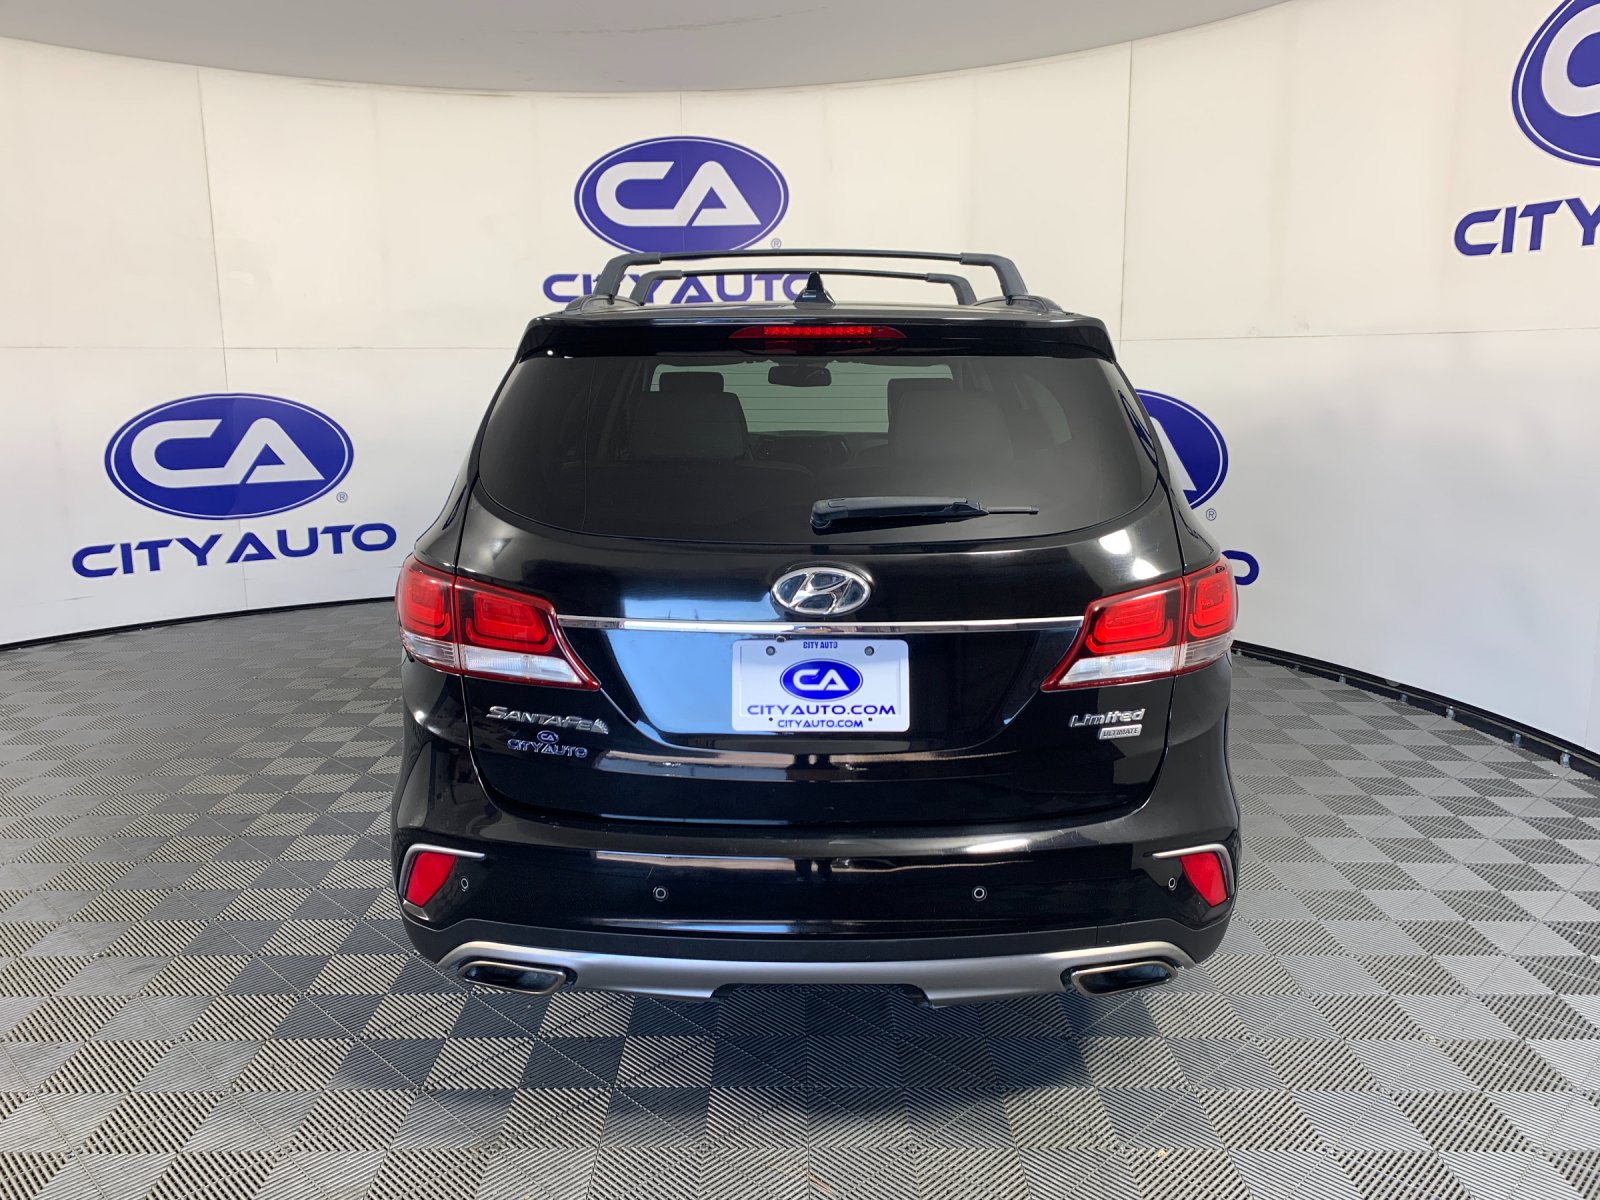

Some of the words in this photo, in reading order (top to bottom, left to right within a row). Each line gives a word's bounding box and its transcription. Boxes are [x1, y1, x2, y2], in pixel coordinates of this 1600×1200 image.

[596, 160, 762, 227] CA
[130, 417, 326, 489] CA
[803, 641, 818, 649] CITY
[820, 641, 838, 649] AUTO
[792, 668, 851, 691] CA
[747, 704, 896, 715] CITYAUTO.COM
[777, 719, 864, 728] CITYAUTO.COM
[1069, 708, 1146, 727] Limited
[1102, 727, 1140, 738] ULTIMATE
